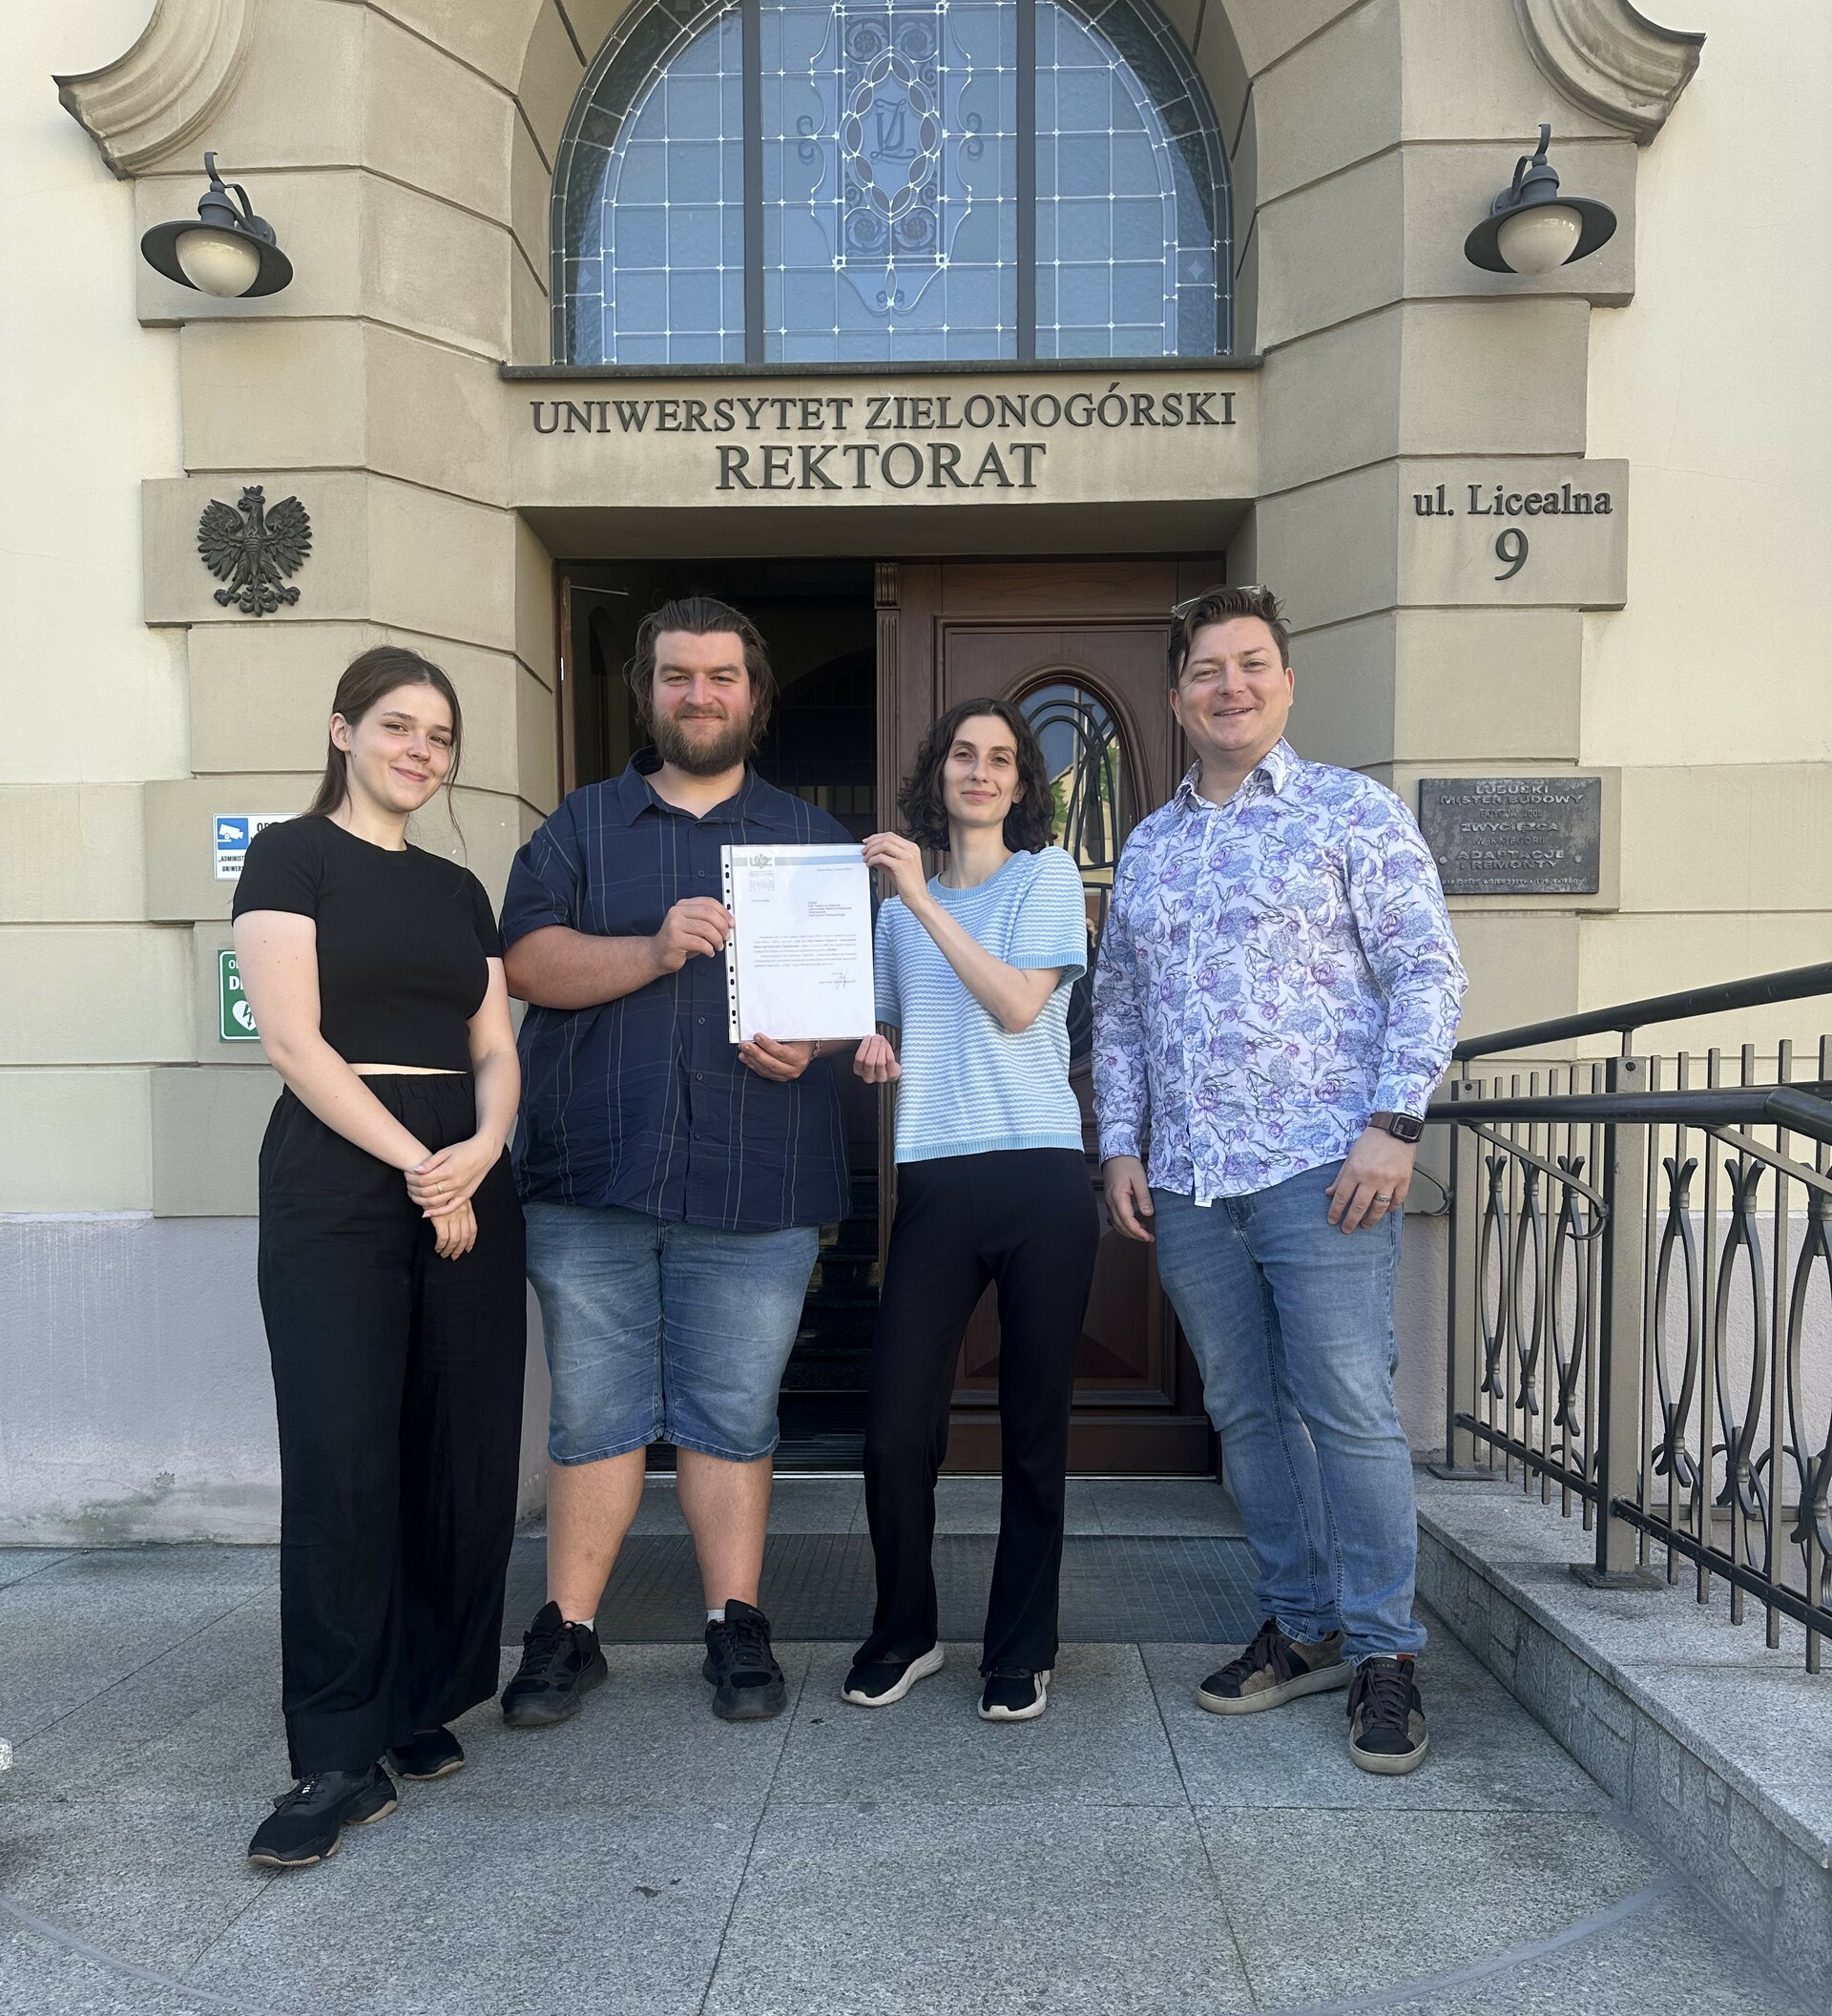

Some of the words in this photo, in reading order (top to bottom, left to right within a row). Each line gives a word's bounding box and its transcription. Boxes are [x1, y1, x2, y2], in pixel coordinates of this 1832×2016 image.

[530, 395, 852, 434] UNIWERSYTET
[864, 383, 1238, 429] ZIELONOGÓRSKI
[715, 442, 1048, 490] REKTORAT
[1413, 483, 1455, 516] ul.
[1468, 483, 1613, 515] Licealna
[1494, 528, 1529, 581] 9
[1440, 795, 1504, 805] MISTER
[1507, 794, 1585, 804] BUDOWY
[1474, 784, 1550, 795] LUBUSKI
[1456, 849, 1565, 860] ADAPTACJE
[1470, 860, 1557, 870] REMONTY
